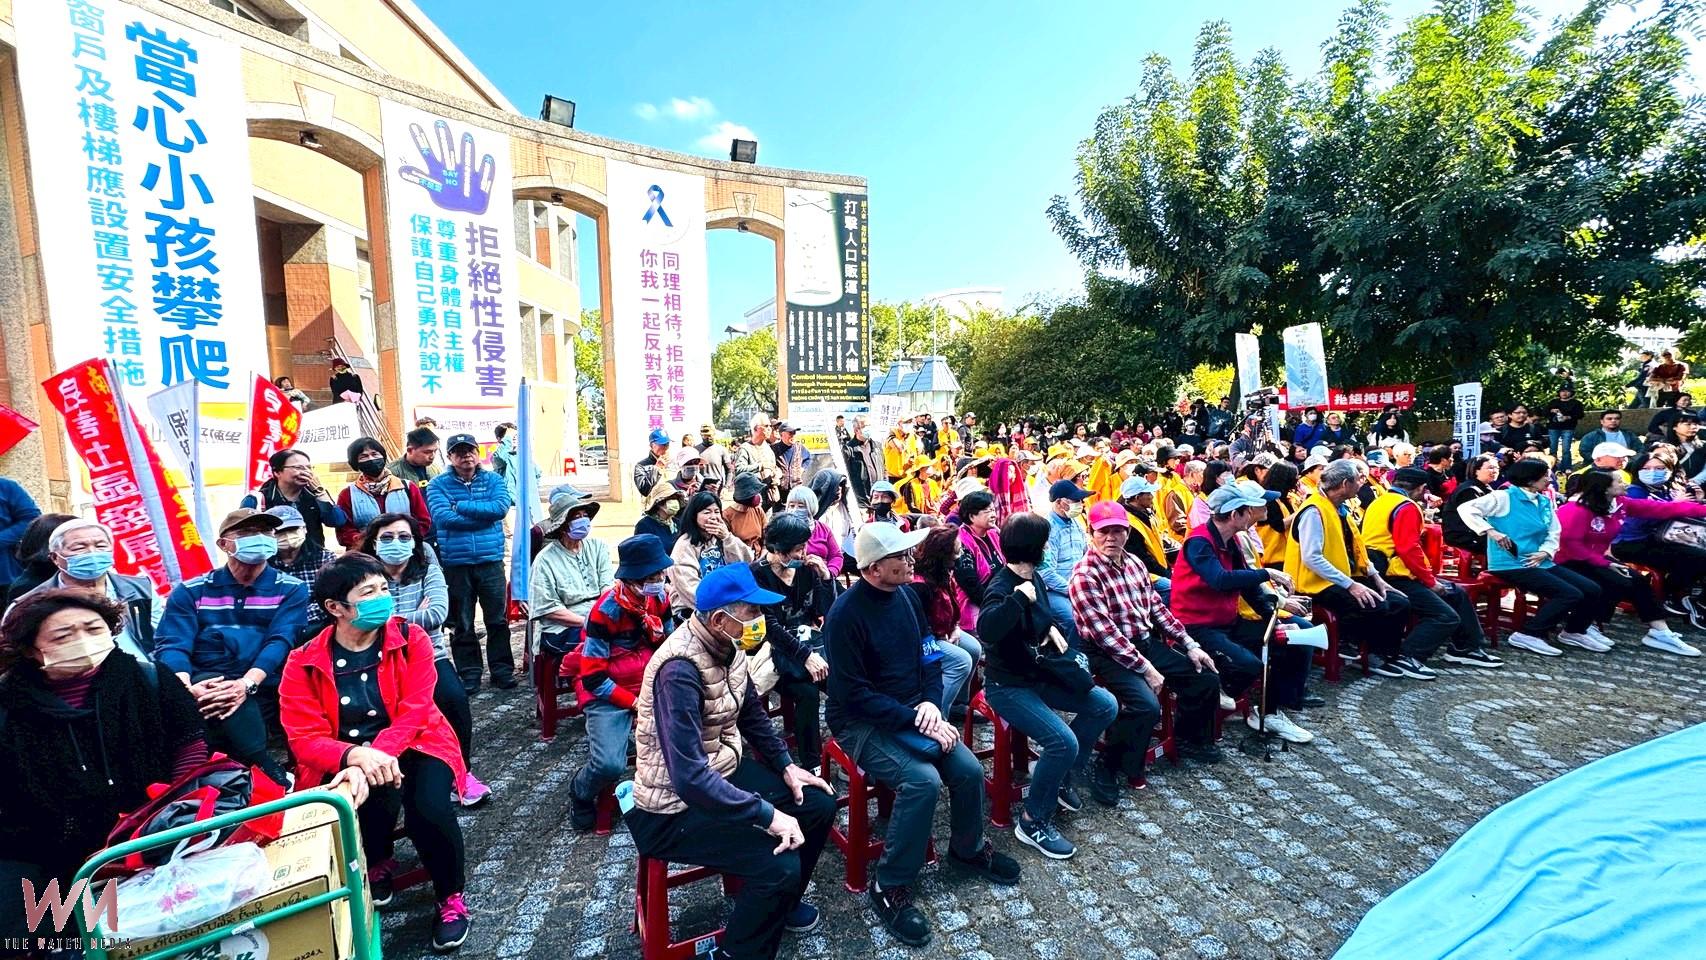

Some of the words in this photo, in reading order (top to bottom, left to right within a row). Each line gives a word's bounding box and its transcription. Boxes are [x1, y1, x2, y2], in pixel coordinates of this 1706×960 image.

[125, 20, 231, 391] 當心小孩攀爬
[410, 213, 443, 395] 保護自己勇於說不
[436, 218, 465, 373] 尊重身體自主權
[464, 221, 508, 397] 拒絕性侵害
[1334, 390, 1410, 406] 拒絕掩埋場
